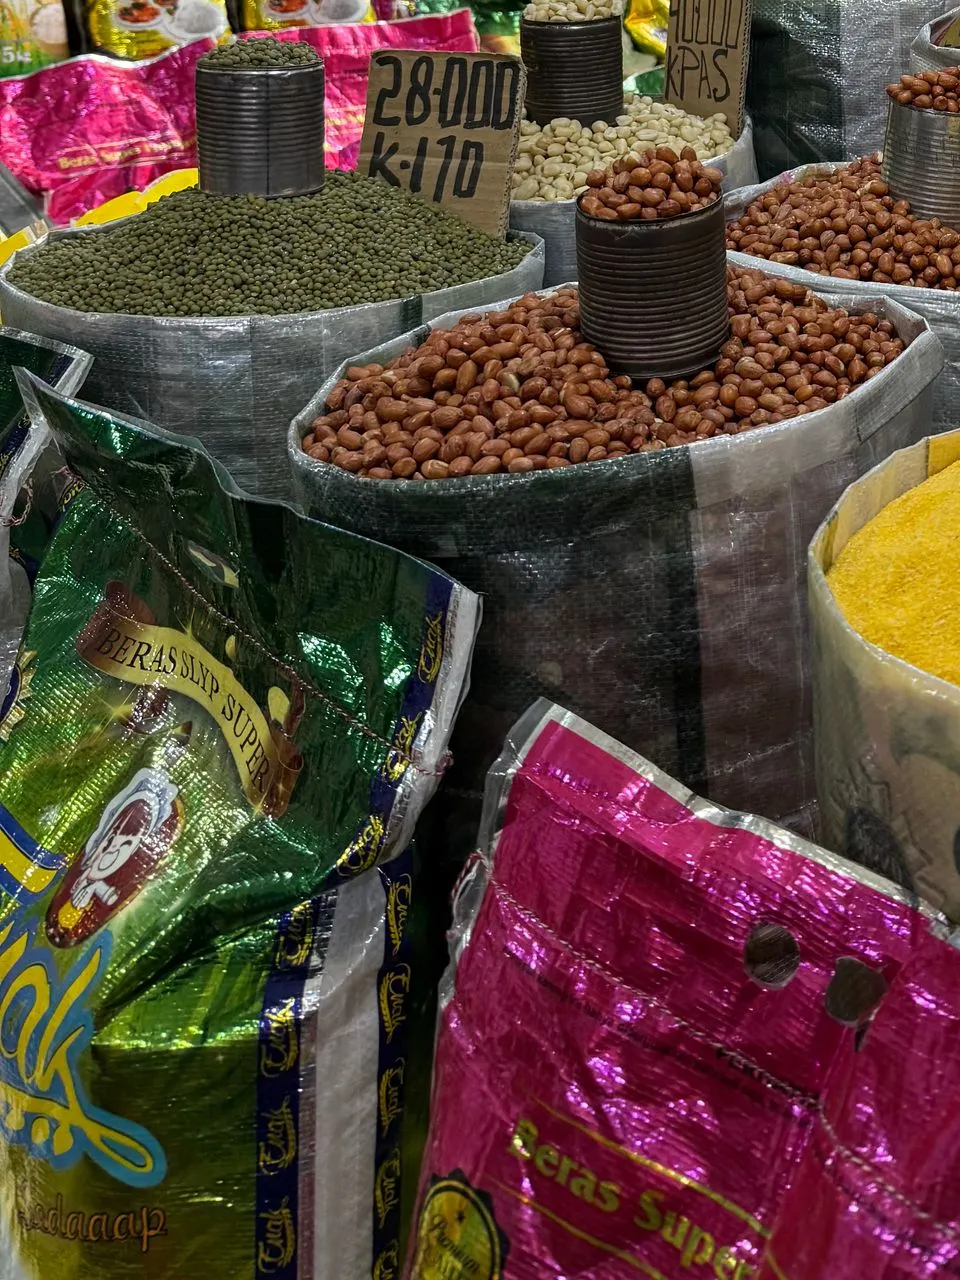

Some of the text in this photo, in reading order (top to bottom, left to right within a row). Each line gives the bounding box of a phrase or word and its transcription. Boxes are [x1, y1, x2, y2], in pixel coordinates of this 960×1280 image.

[372, 56, 520, 130] 28.000
[94, 627, 271, 793] BERAS SLYP SUPER
[509, 1119, 620, 1213] Beras
